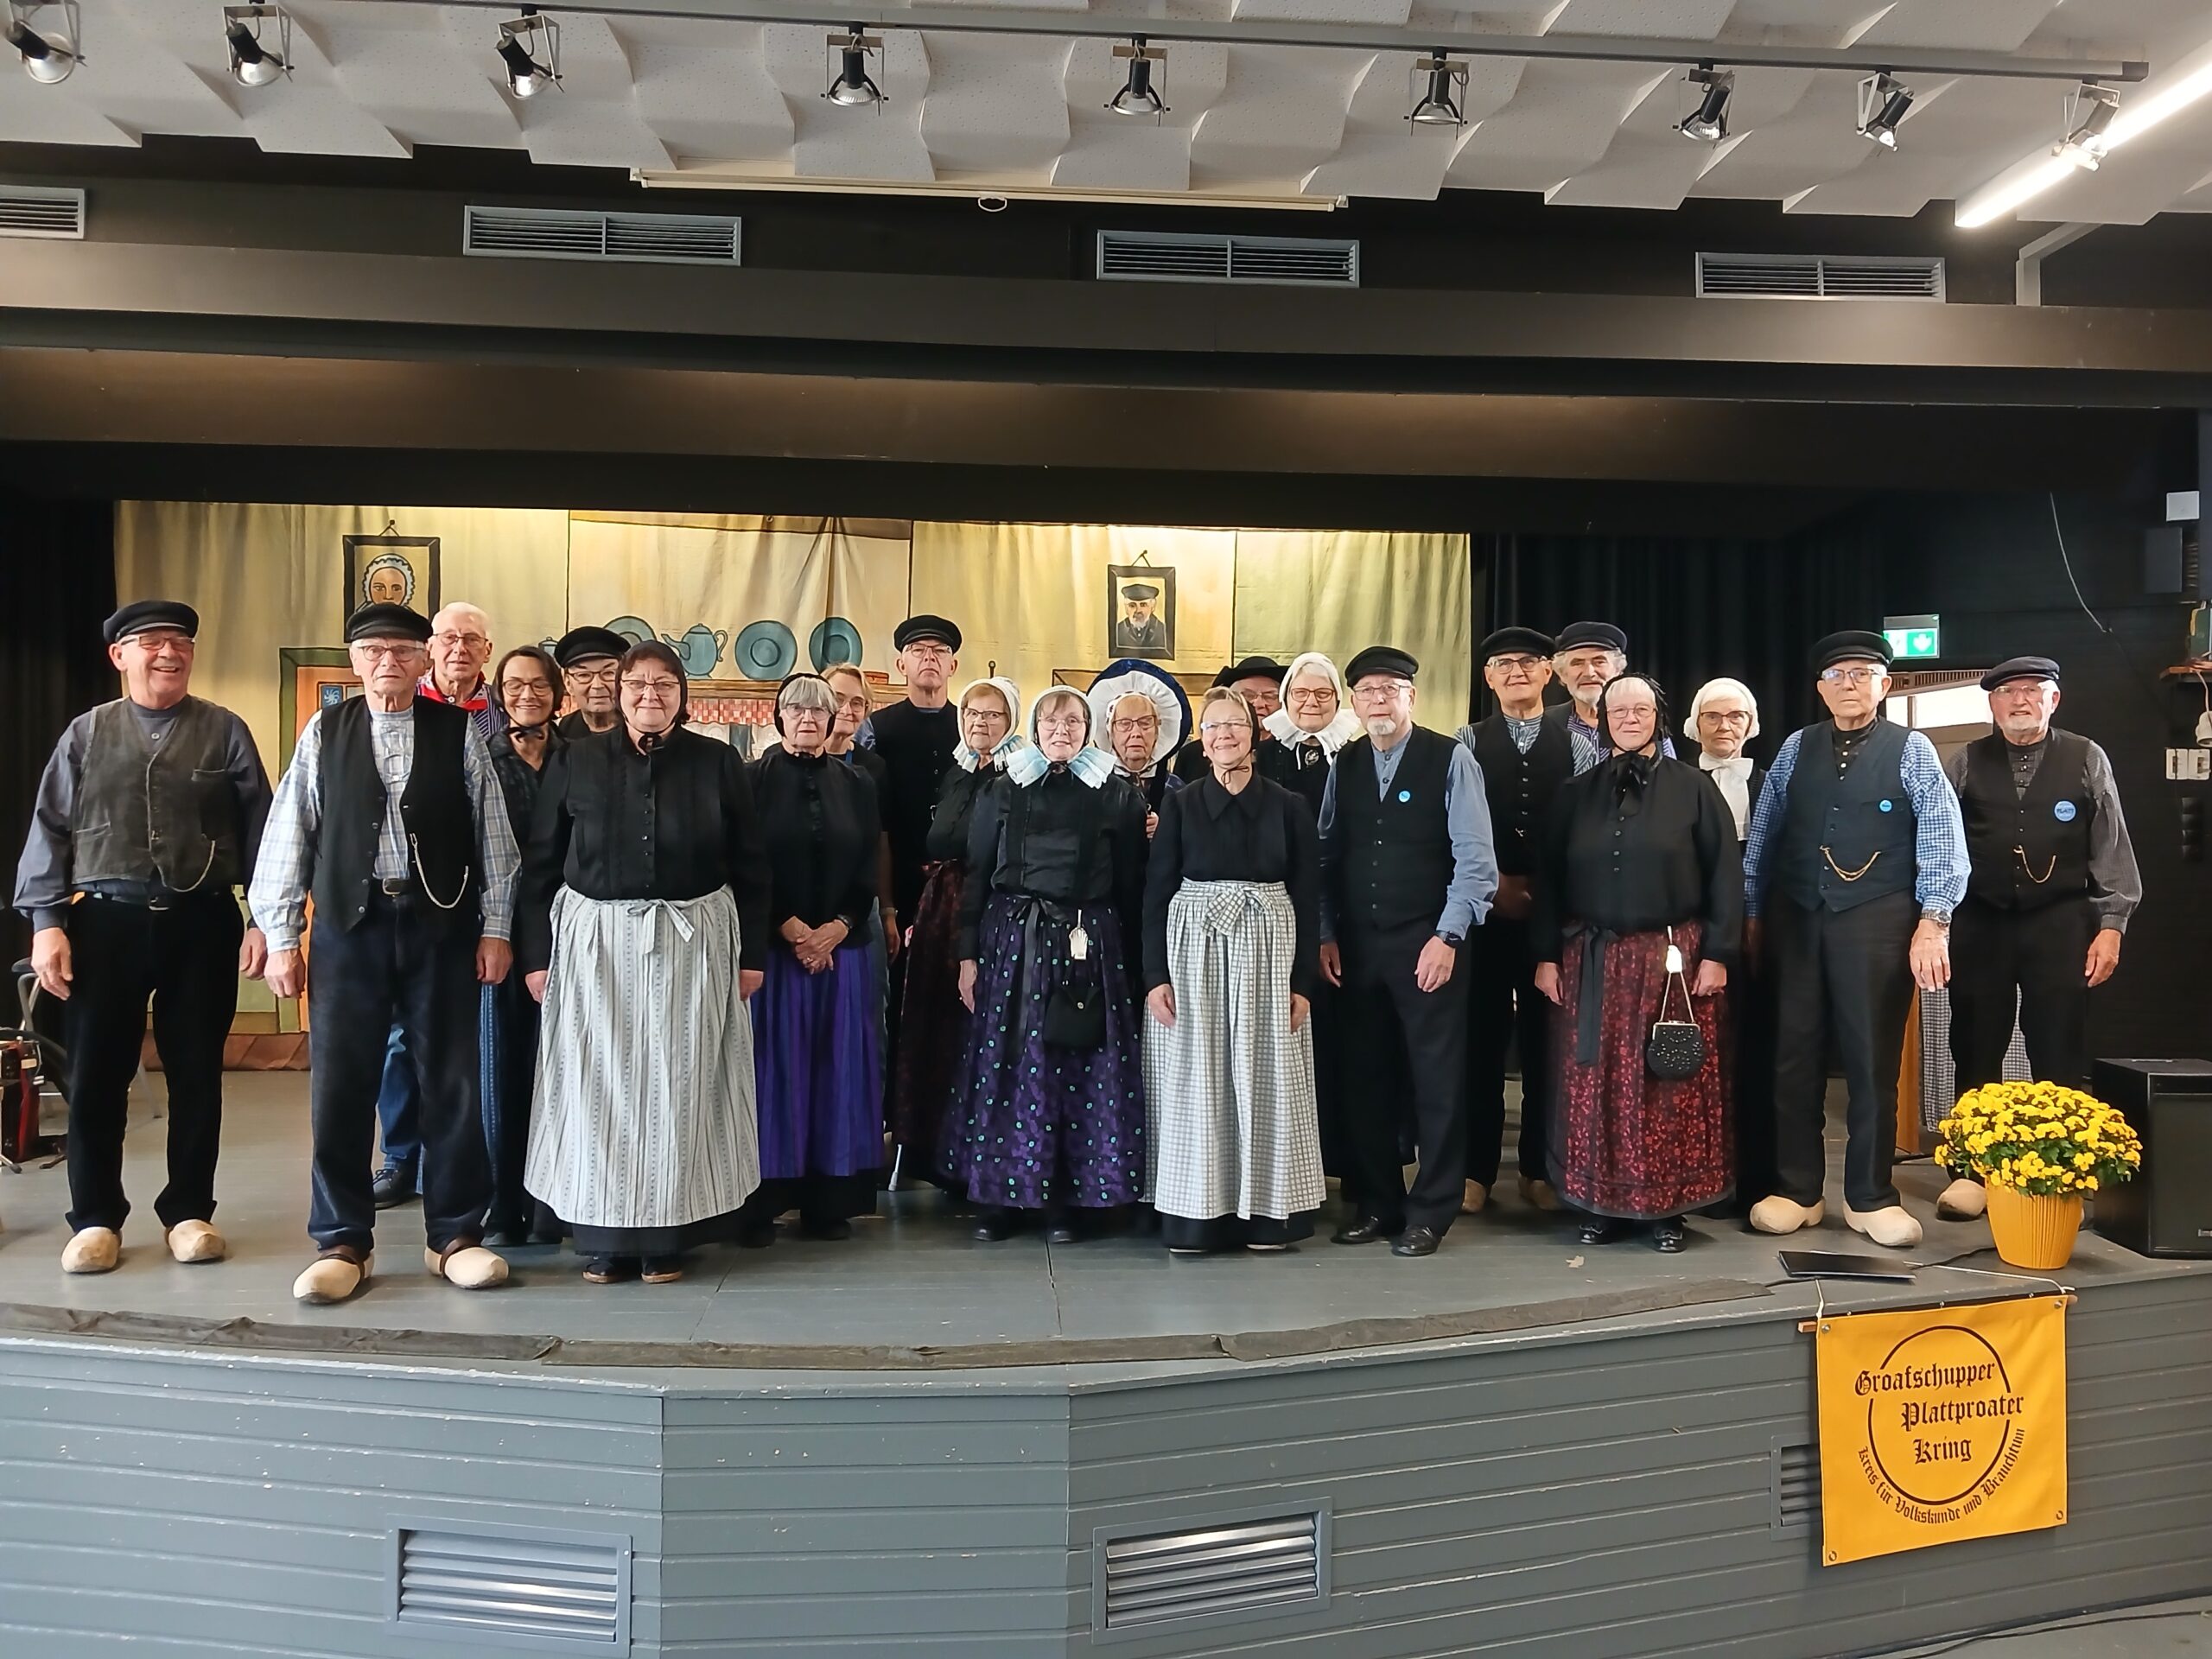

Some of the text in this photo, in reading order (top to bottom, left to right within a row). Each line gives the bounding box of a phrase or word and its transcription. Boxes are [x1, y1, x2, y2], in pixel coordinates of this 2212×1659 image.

[1855, 1363, 1995, 1395] Groafschupper
[1901, 1395, 2024, 1432] Plattproater
[1913, 1436, 1972, 1465] Kring
[1858, 1428, 2025, 1524] Kreis für Volkskunde und Brauchtum
